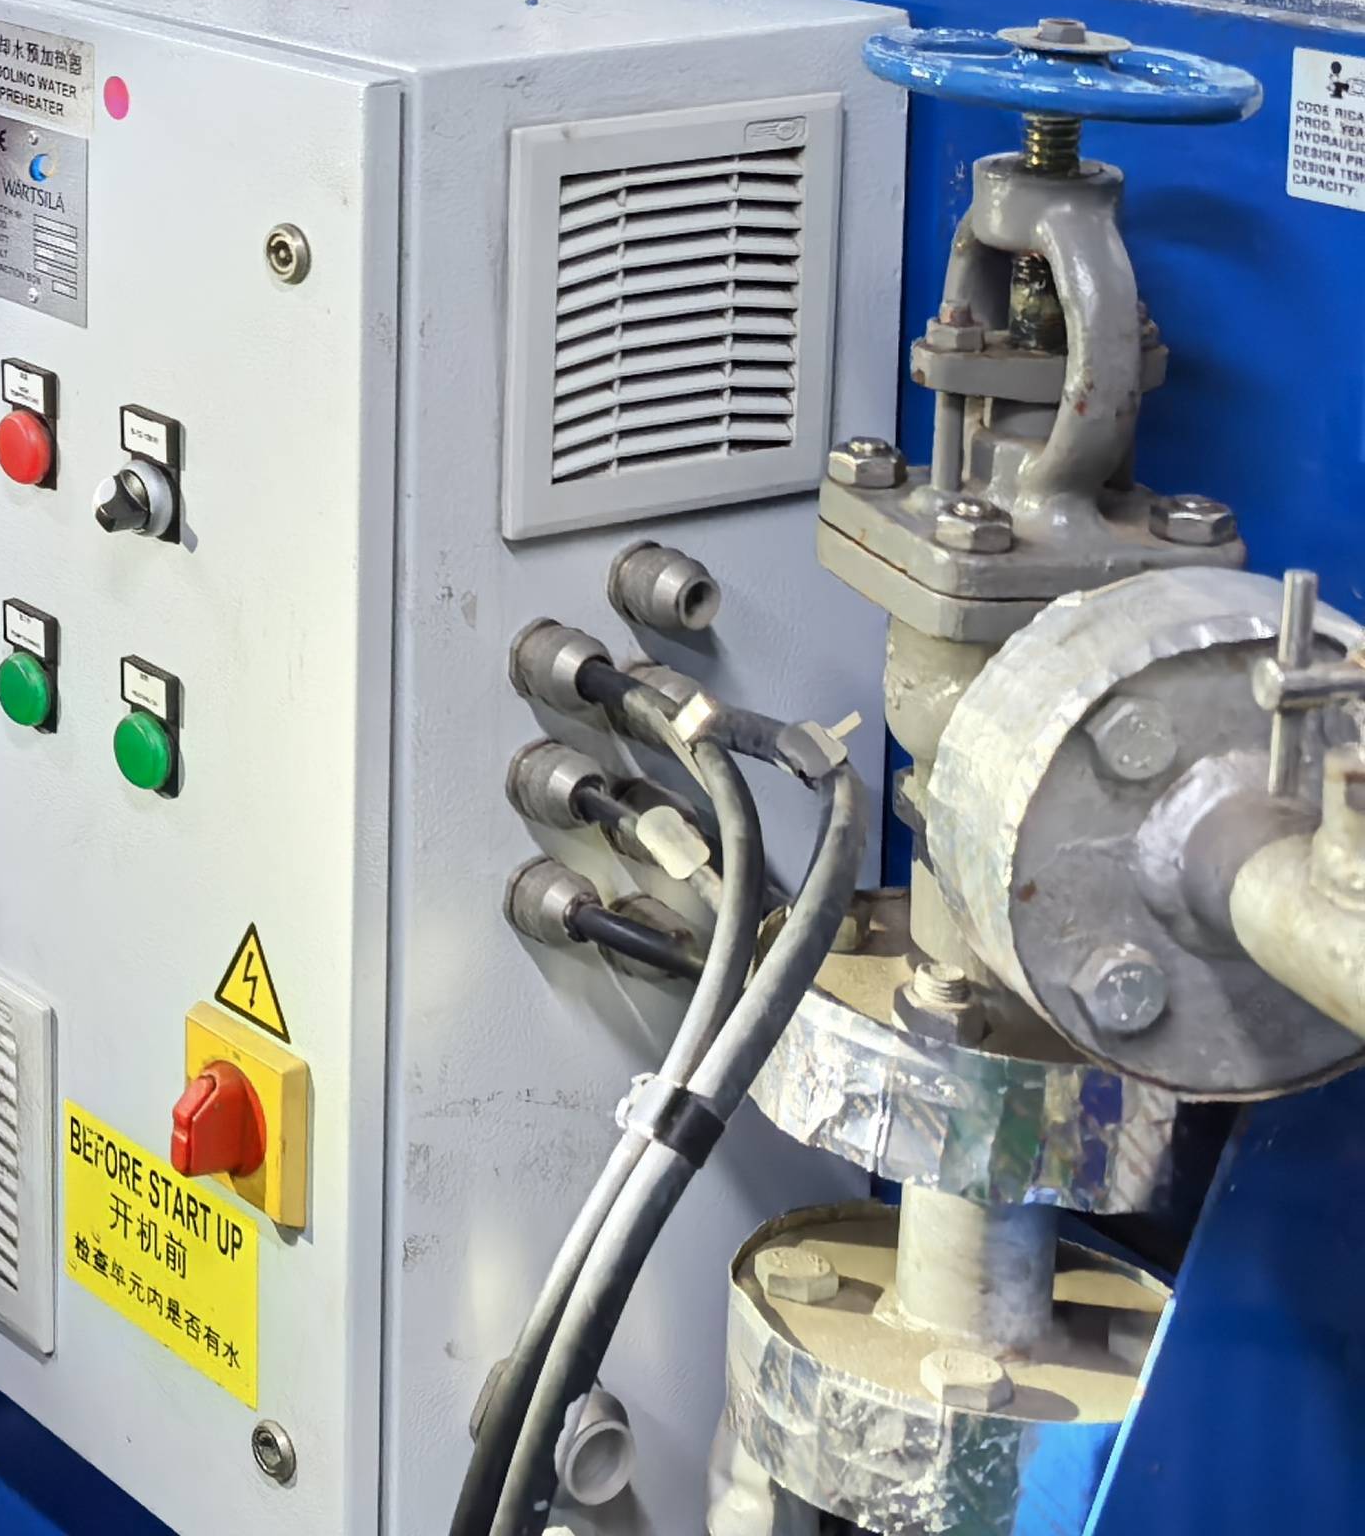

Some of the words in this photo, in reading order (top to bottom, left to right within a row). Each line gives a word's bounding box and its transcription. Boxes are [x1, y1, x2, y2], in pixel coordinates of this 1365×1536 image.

[0, 86, 64, 116] PREHEATER
[37, 75, 77, 98] WATER
[69, 1116, 143, 1198] BEFORE
[149, 1169, 211, 1243] START
[216, 1212, 243, 1262] UP
[109, 1192, 187, 1280] 开机前
[74, 1231, 241, 1369] 检查单元内是否有水
